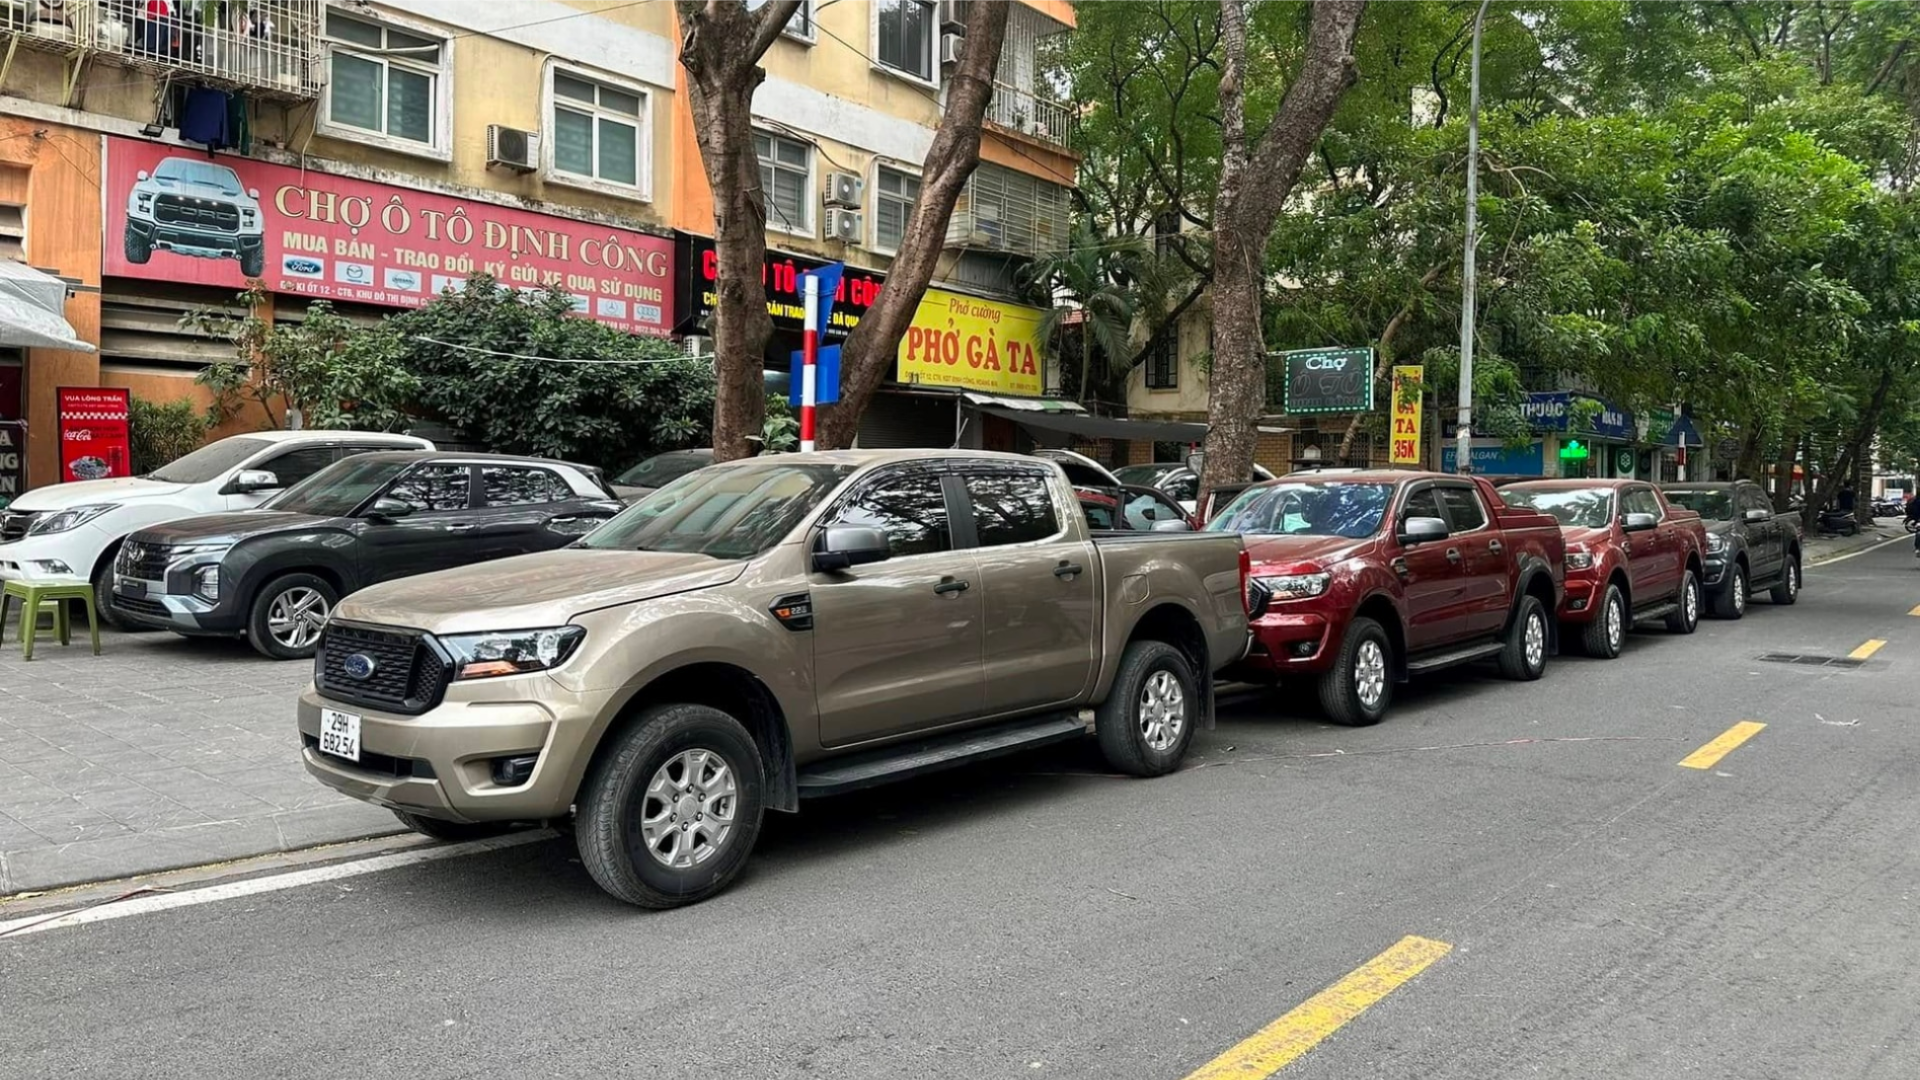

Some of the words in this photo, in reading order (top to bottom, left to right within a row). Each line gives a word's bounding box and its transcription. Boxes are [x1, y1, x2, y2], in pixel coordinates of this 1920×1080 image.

[274, 185, 373, 236] CHỢ
[381, 194, 411, 234] Ô
[421, 206, 474, 245] TÔ
[482, 219, 571, 261] ĐỊNH
[579, 234, 668, 278] CÔNG
[283, 231, 328, 254] MUA
[335, 238, 375, 260] BÁN
[394, 247, 439, 270] TRAO
[484, 260, 506, 280] KÝ
[542, 270, 563, 287] XE
[567, 274, 596, 293] QUA
[601, 276, 621, 295] SỬ
[625, 283, 662, 303] DỤNG
[772, 259, 796, 293] TÔ
[320, 285, 331, 295] 12
[356, 290, 373, 300] KHU
[906, 317, 961, 366] PHỞ
[966, 327, 1001, 372] GÀ
[1007, 340, 1037, 375] TA
[1306, 356, 1347, 371] Chợ
[81, 394, 101, 402] LÒNG
[1395, 419, 1416, 433] TA
[1394, 440, 1415, 458] 35K
[331, 711, 349, 734] 29H
